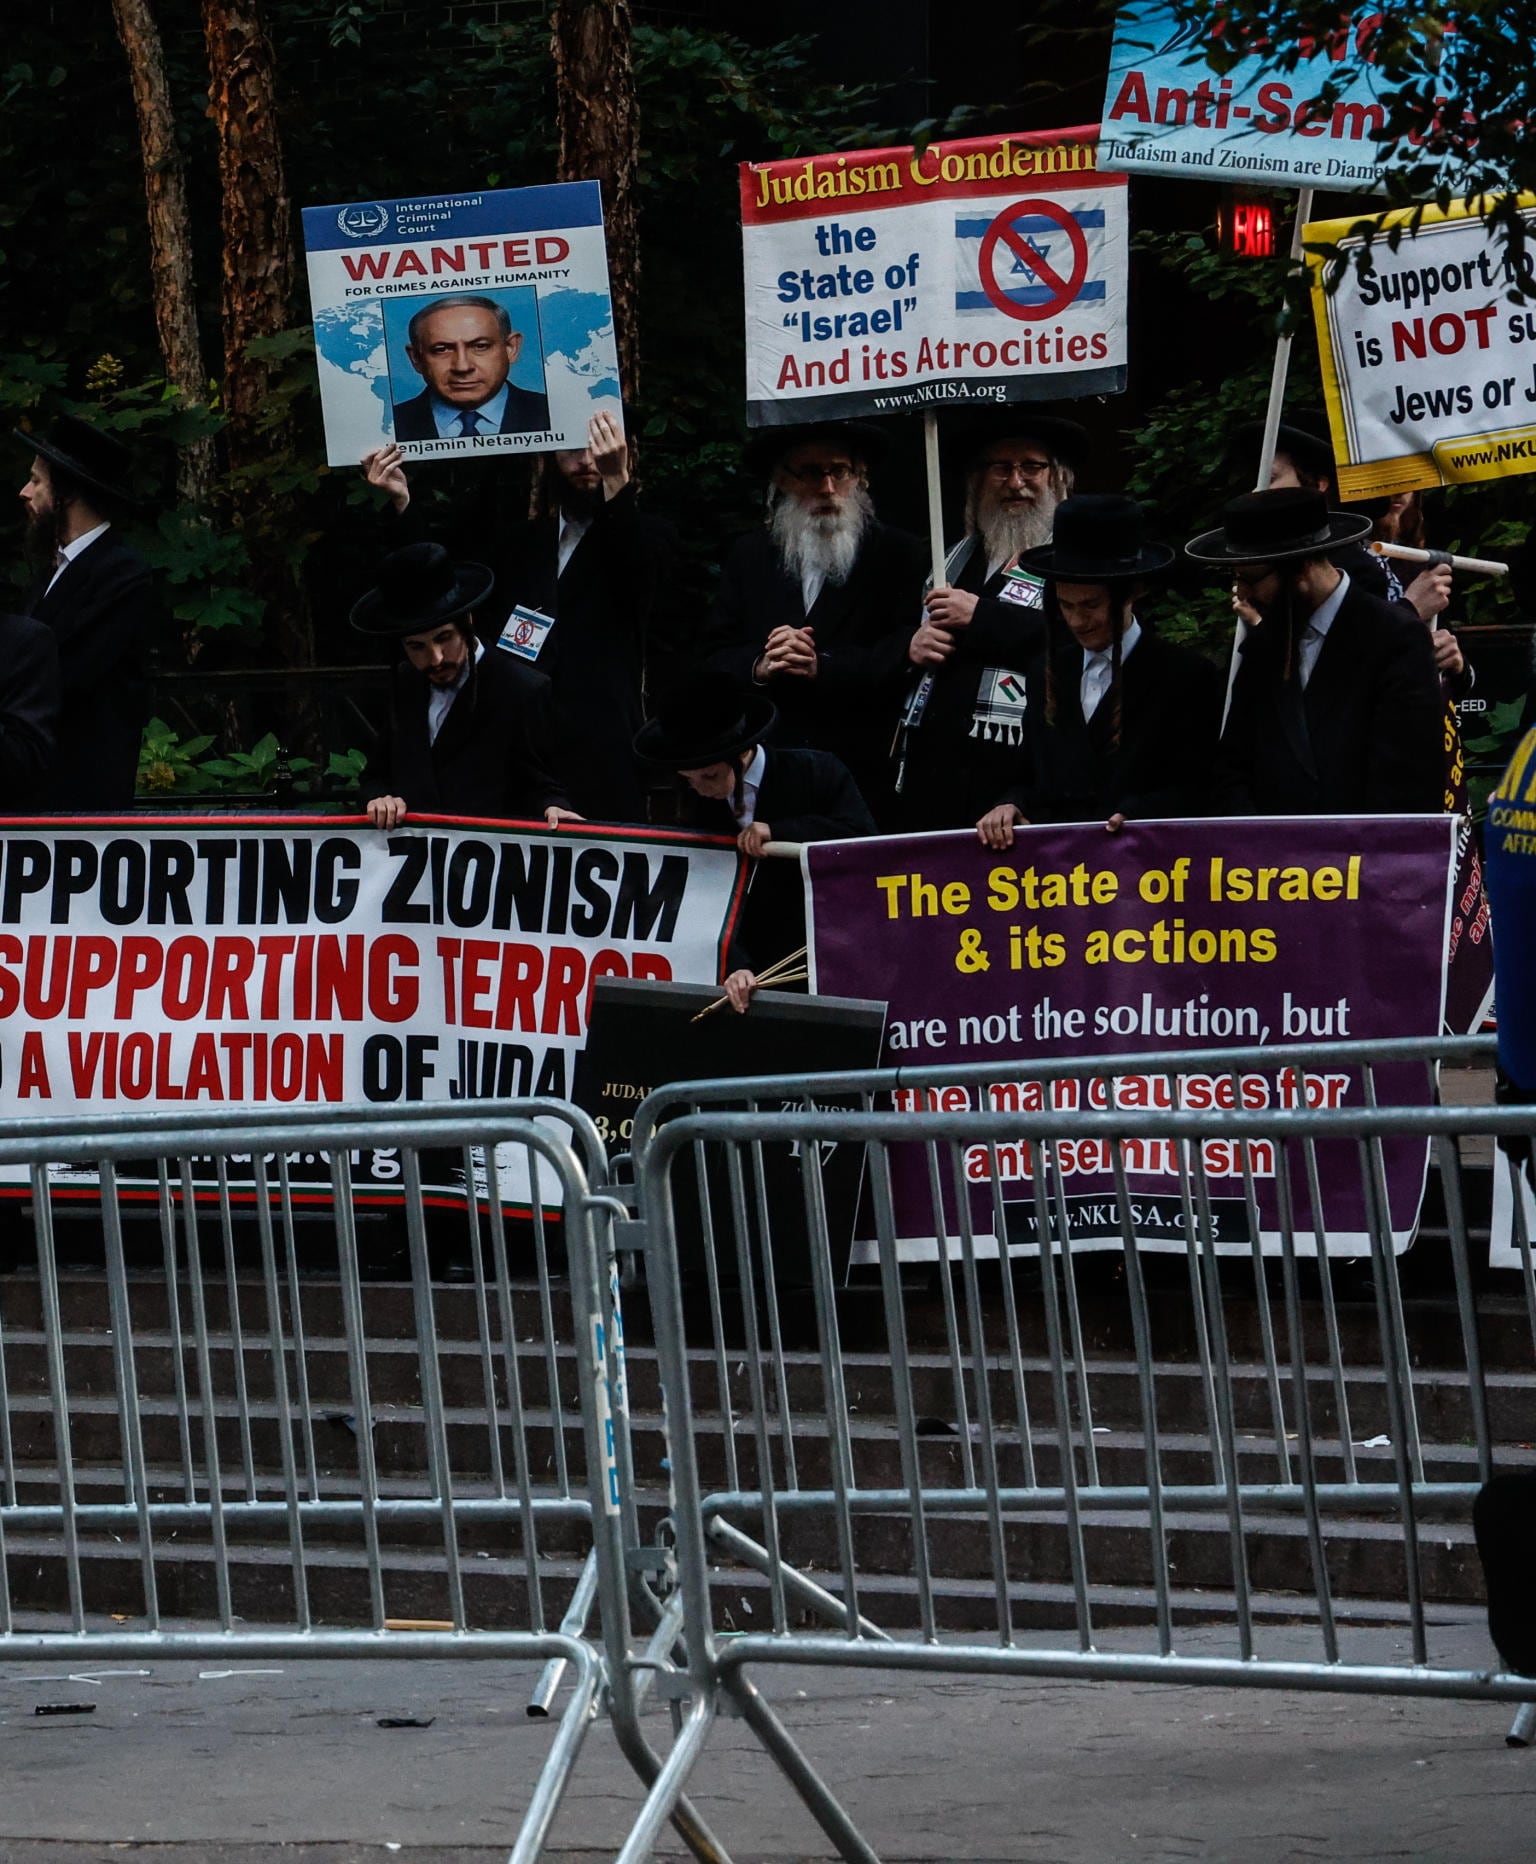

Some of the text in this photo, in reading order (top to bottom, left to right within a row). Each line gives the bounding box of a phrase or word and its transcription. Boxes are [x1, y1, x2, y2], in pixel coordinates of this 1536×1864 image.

[756, 139, 1101, 208] Judaism Condemn
[1107, 140, 1177, 165] Judaism
[1181, 144, 1214, 166] and
[1218, 149, 1290, 173] Zionism
[1293, 160, 1322, 175] are
[395, 196, 482, 212] International
[396, 210, 452, 223] Criminal
[397, 223, 436, 235] Court
[815, 223, 877, 257] the
[340, 236, 571, 281] WANTED
[777, 253, 920, 303] State of
[1358, 250, 1493, 309] Support
[345, 268, 571, 297] FOR CRIMES AGAINST HUMANITY
[776, 325, 1108, 390] And its Atrocities
[1354, 331, 1383, 368] is
[1392, 306, 1498, 362] NOT
[873, 381, 1007, 409] www.NKUSA.org
[1389, 383, 1474, 425] Jews
[1483, 376, 1516, 409] or
[386, 430, 565, 455] enjamin Netanyahu
[1451, 440, 1536, 469] www.NKU
[381, 836, 689, 943] ZIONISM
[876, 854, 1361, 920] The State of Israel
[954, 918, 1277, 974] & its actions
[888, 992, 1351, 1050] are not the solution, but
[17, 1031, 52, 1099] A
[67, 1031, 344, 1102] VIOLATION
[363, 1033, 440, 1102] OF
[988, 1077, 1079, 1112] man
[1279, 1066, 1351, 1110] for
